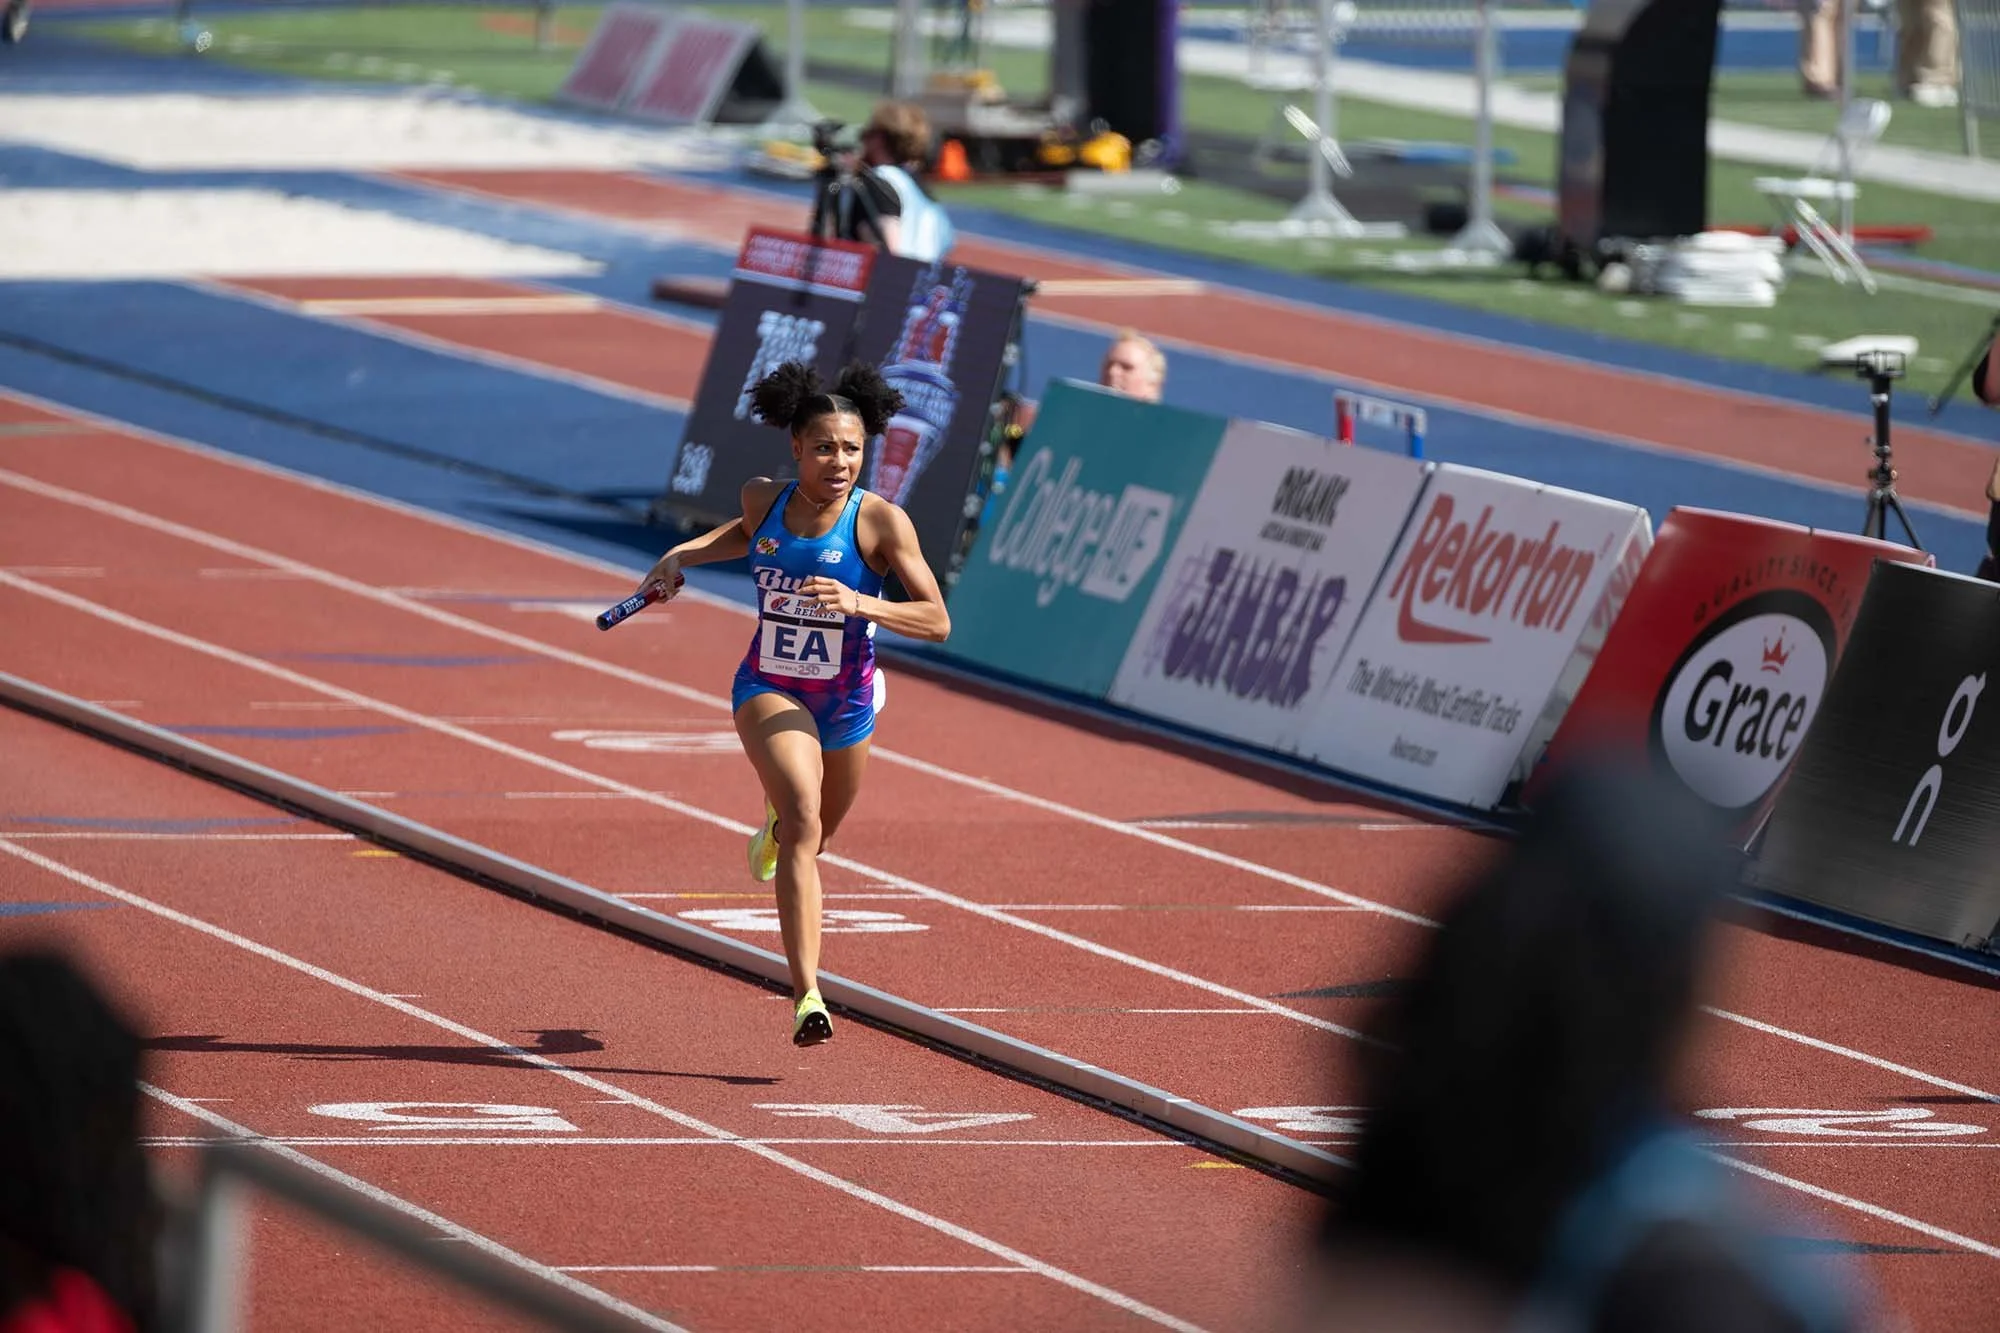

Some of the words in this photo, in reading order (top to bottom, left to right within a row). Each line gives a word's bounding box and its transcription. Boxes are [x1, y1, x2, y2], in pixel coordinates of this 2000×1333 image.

[1389, 493, 1595, 643] Rekortan
[1694, 557, 1785, 622] QUALITY
[1790, 556, 1838, 593] SINCE
[773, 626, 830, 662] EA
[1163, 548, 1347, 708] JAMBAR
[1684, 659, 1808, 761] Grace
[307, 1102, 582, 1131] 5
